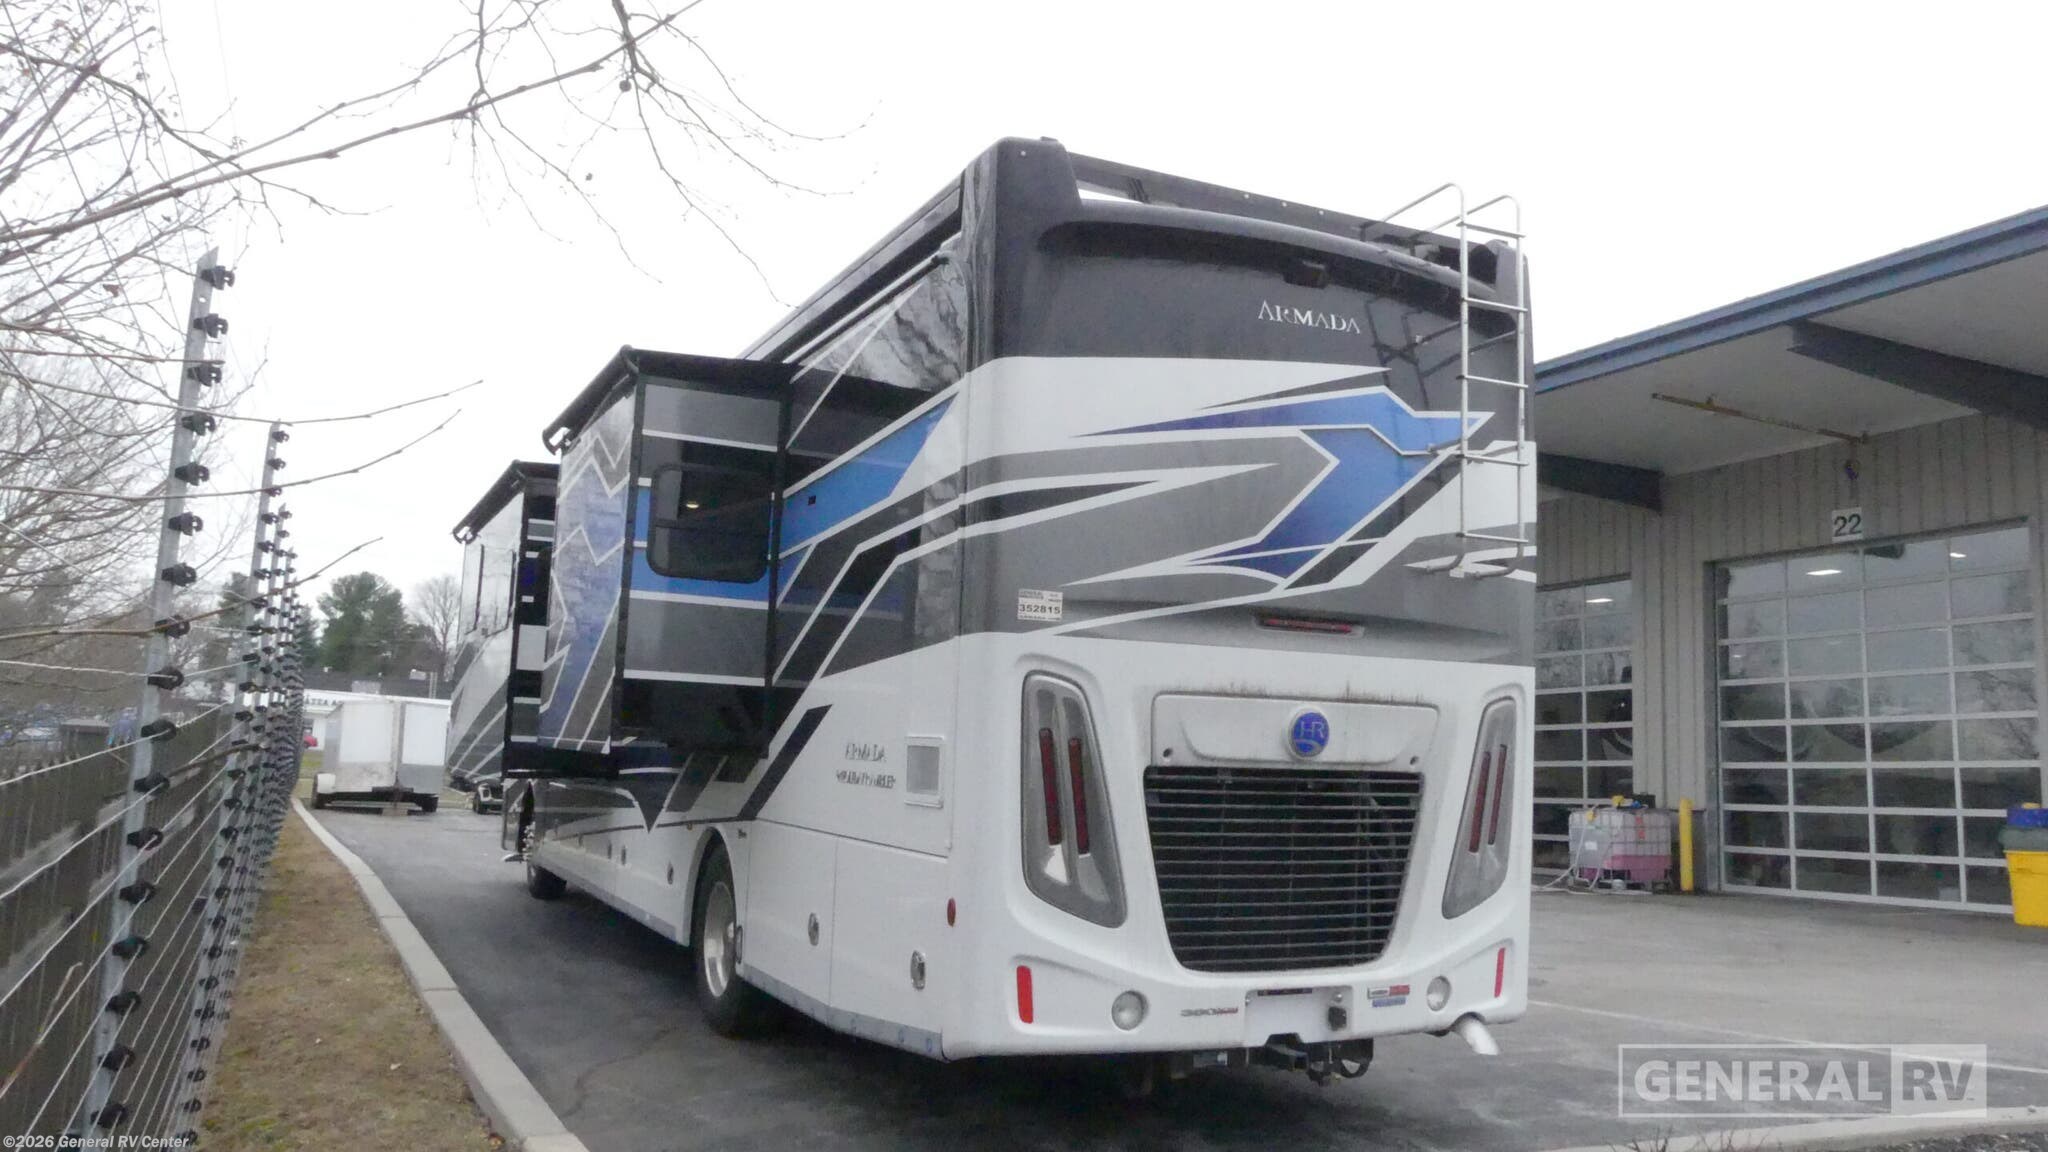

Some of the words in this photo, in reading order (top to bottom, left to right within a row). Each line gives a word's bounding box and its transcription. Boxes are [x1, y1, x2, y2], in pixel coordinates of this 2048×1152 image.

[1258, 300, 1361, 334] ARMADA
[1834, 513, 1862, 537] 22
[1018, 604, 1061, 614] 352815
[1300, 721, 1325, 738] HR
